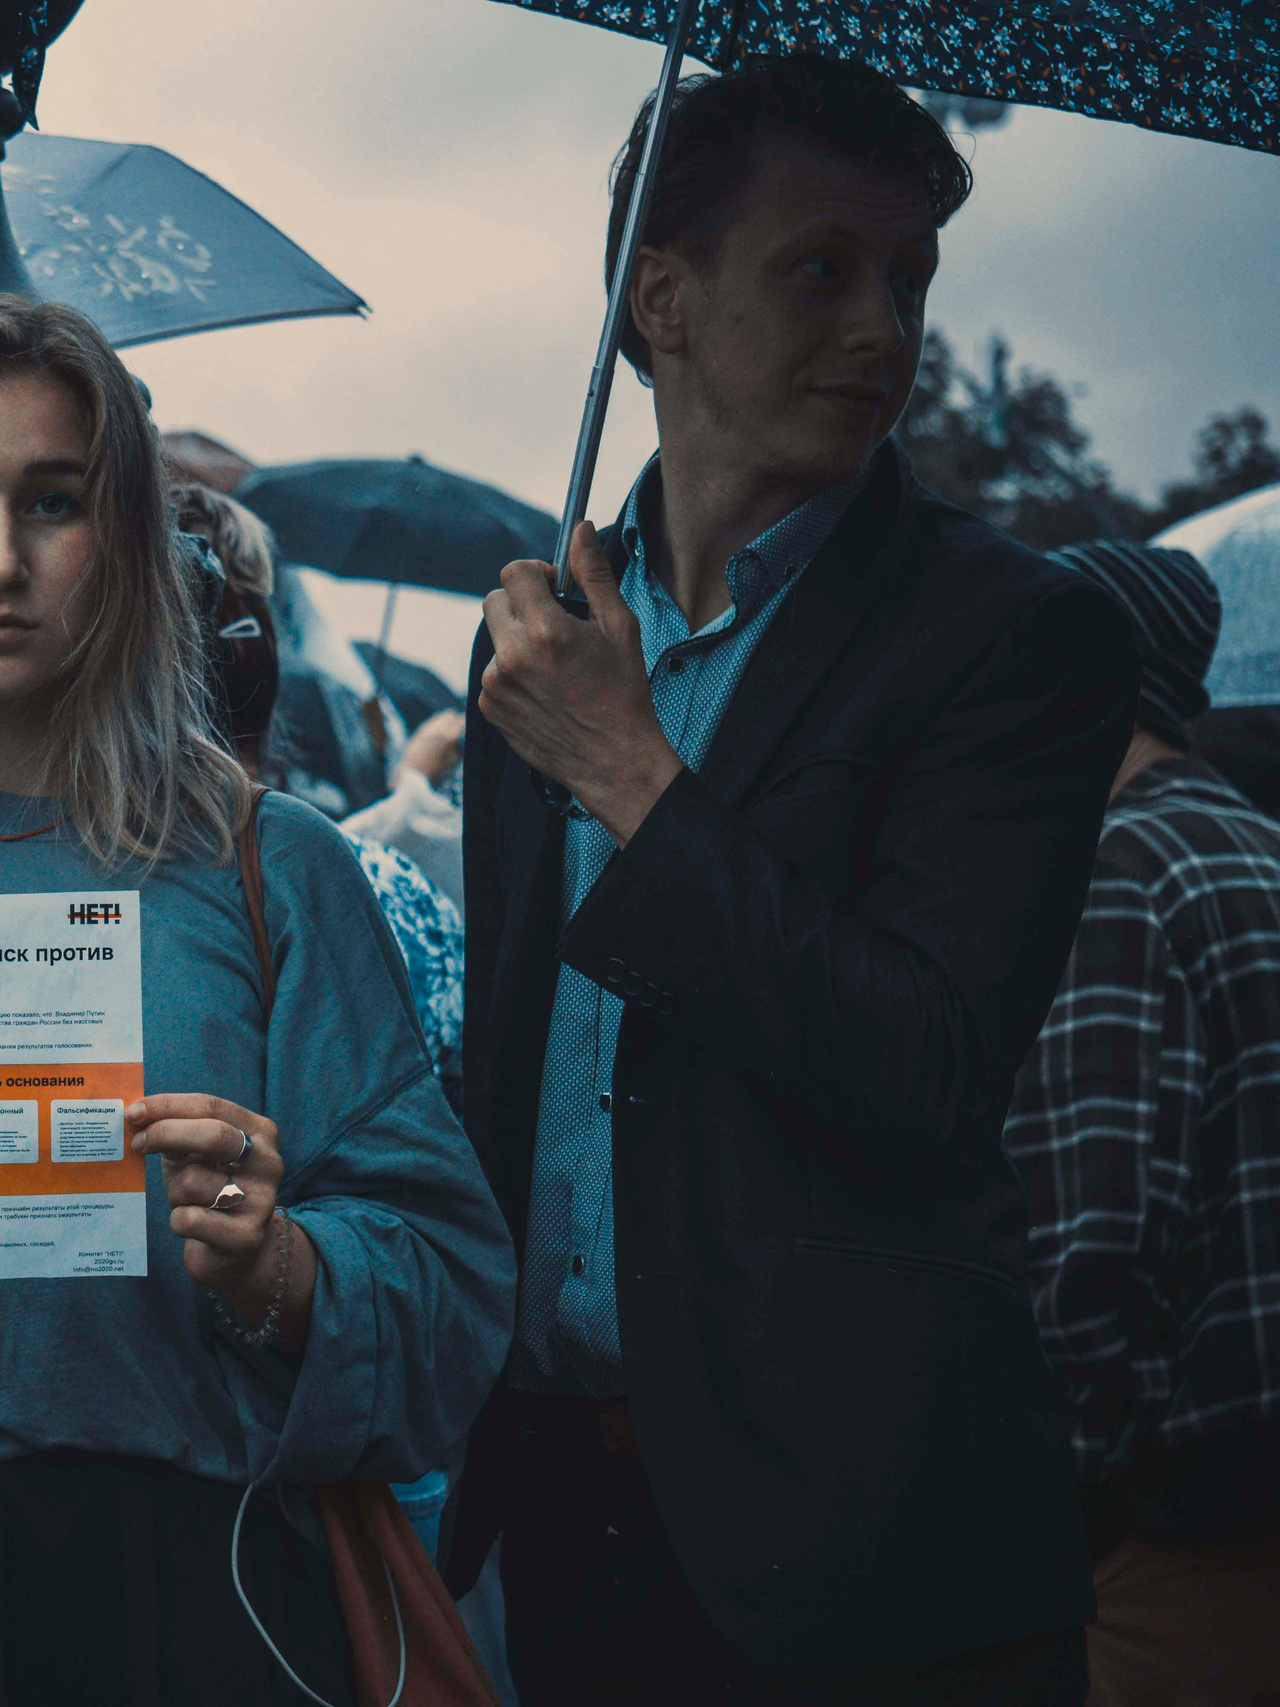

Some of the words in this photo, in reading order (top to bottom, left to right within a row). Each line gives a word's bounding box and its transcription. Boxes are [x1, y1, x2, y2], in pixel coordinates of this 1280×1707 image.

[70, 904, 121, 924] НЕТ!
[36, 945, 113, 966] против
[6, 1075, 85, 1087] основания
